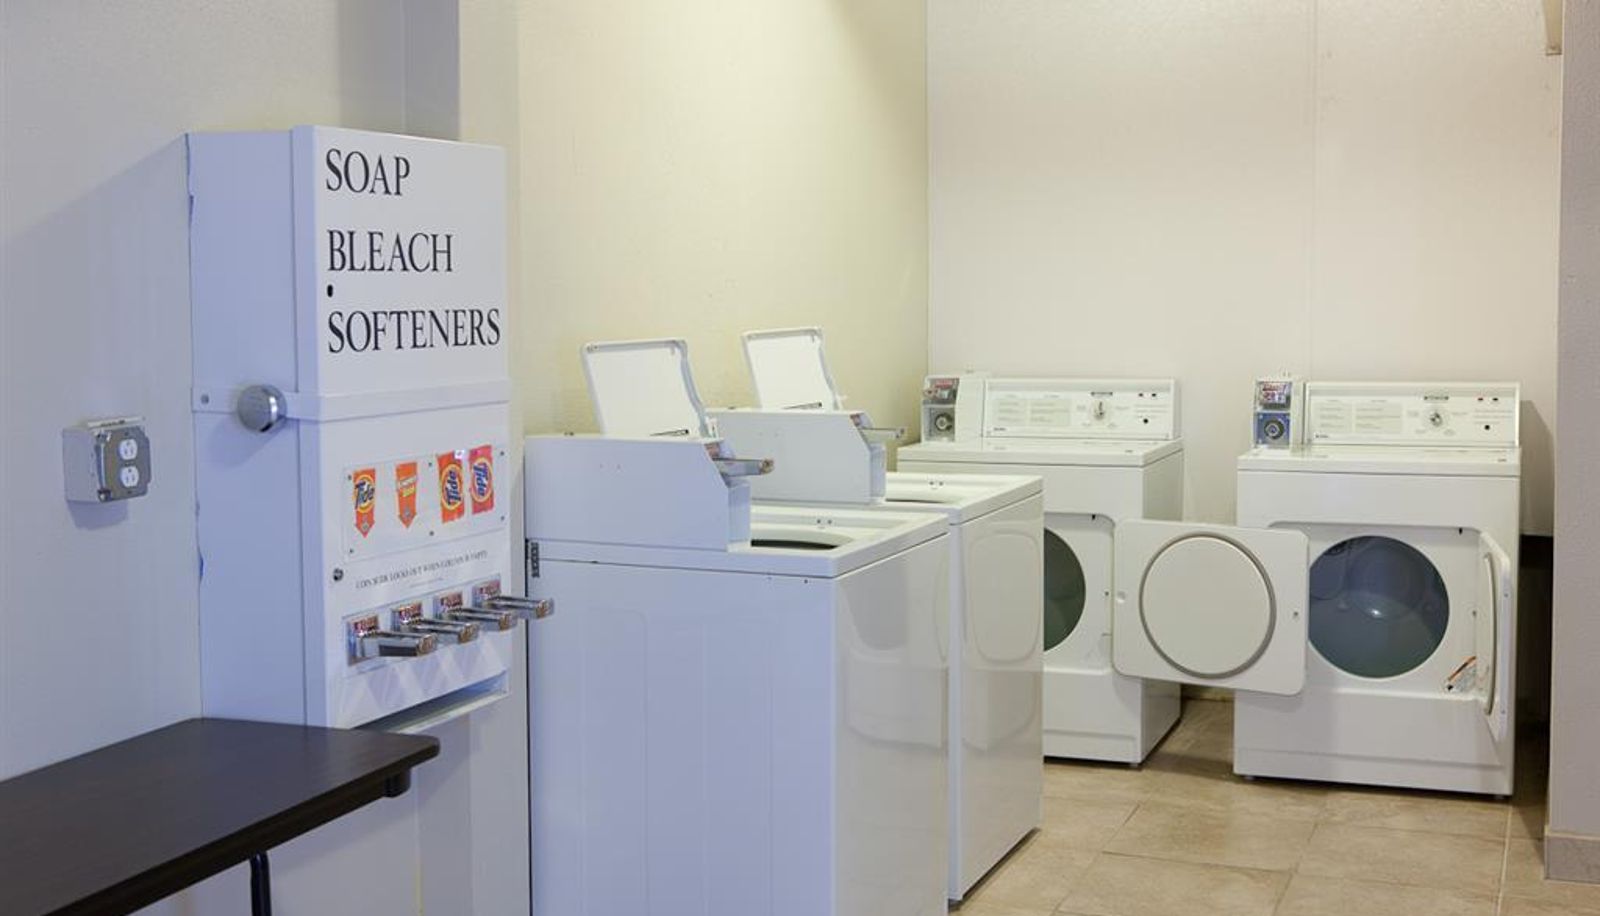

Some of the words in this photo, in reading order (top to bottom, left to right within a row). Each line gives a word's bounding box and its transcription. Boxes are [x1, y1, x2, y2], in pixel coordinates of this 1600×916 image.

[326, 148, 410, 196] SOAP
[328, 229, 453, 273] BLEACH
[328, 308, 501, 354] SOFTENERS
[354, 480, 376, 510] Tide
[445, 469, 462, 506] Tide
[472, 461, 489, 497] Tide
